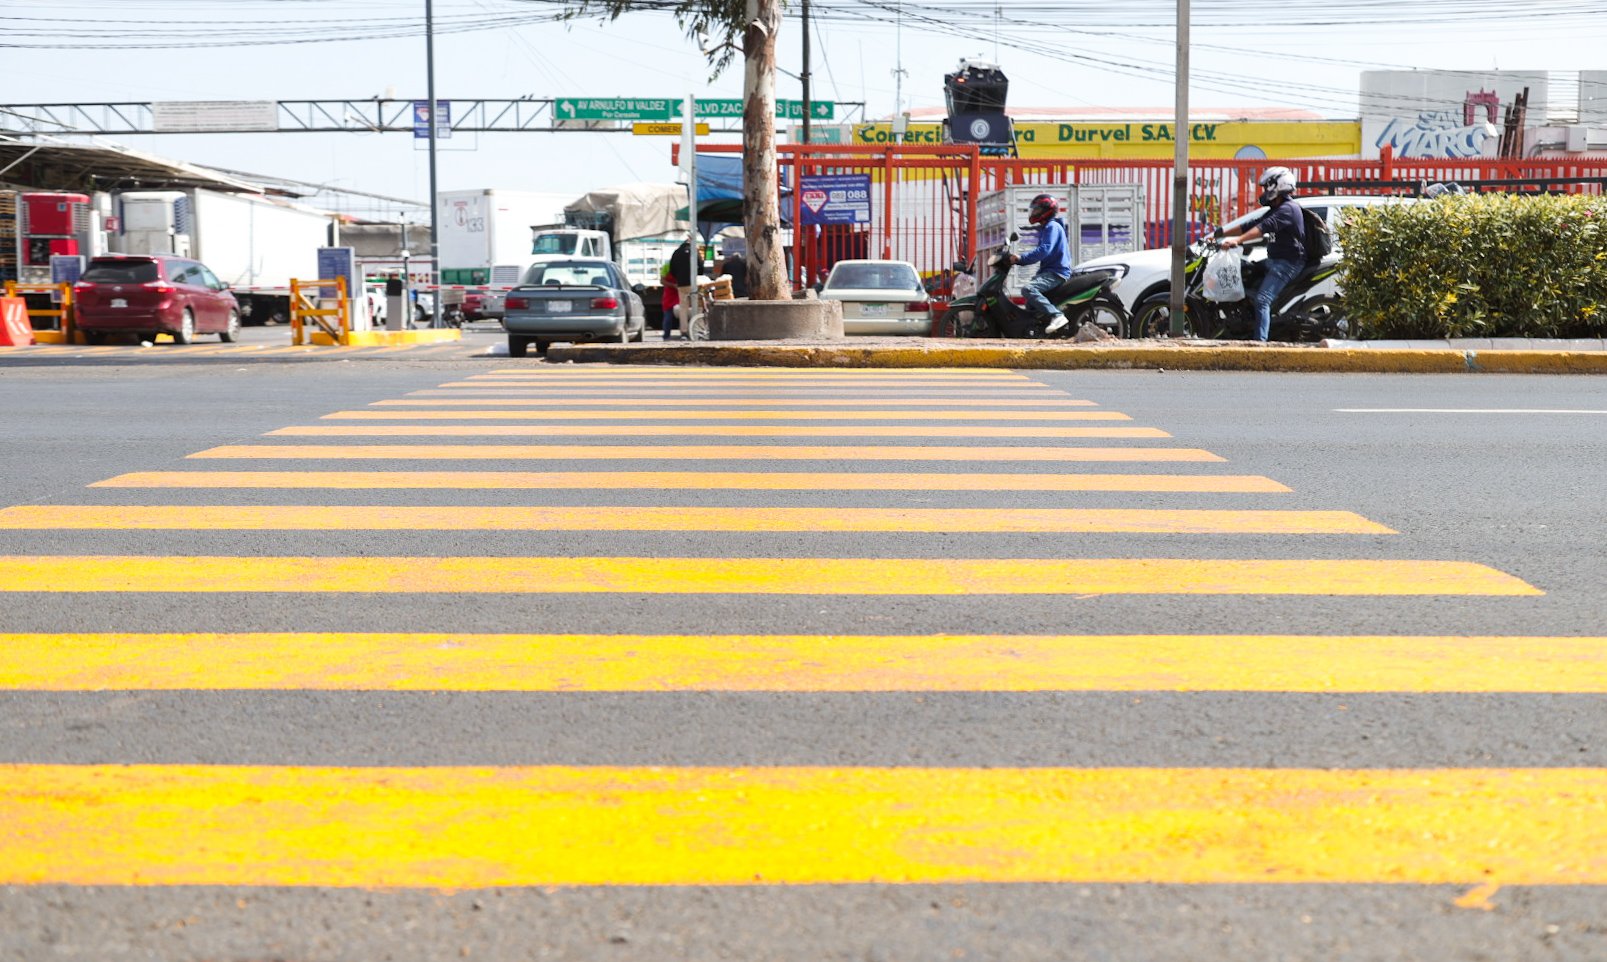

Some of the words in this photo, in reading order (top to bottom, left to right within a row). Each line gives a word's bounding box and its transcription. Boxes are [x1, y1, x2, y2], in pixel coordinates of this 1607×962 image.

[577, 100, 588, 110] AV
[589, 100, 626, 110] ARNULFO
[627, 101, 635, 110] M
[635, 101, 666, 111] VALDEZ
[693, 103, 719, 114] BLVD
[1415, 109, 1462, 132] SAN
[1058, 124, 1130, 141] Durvel
[1141, 124, 1176, 141] S.A.
[1192, 124, 1217, 141] C.V.
[847, 190, 868, 199] 088
